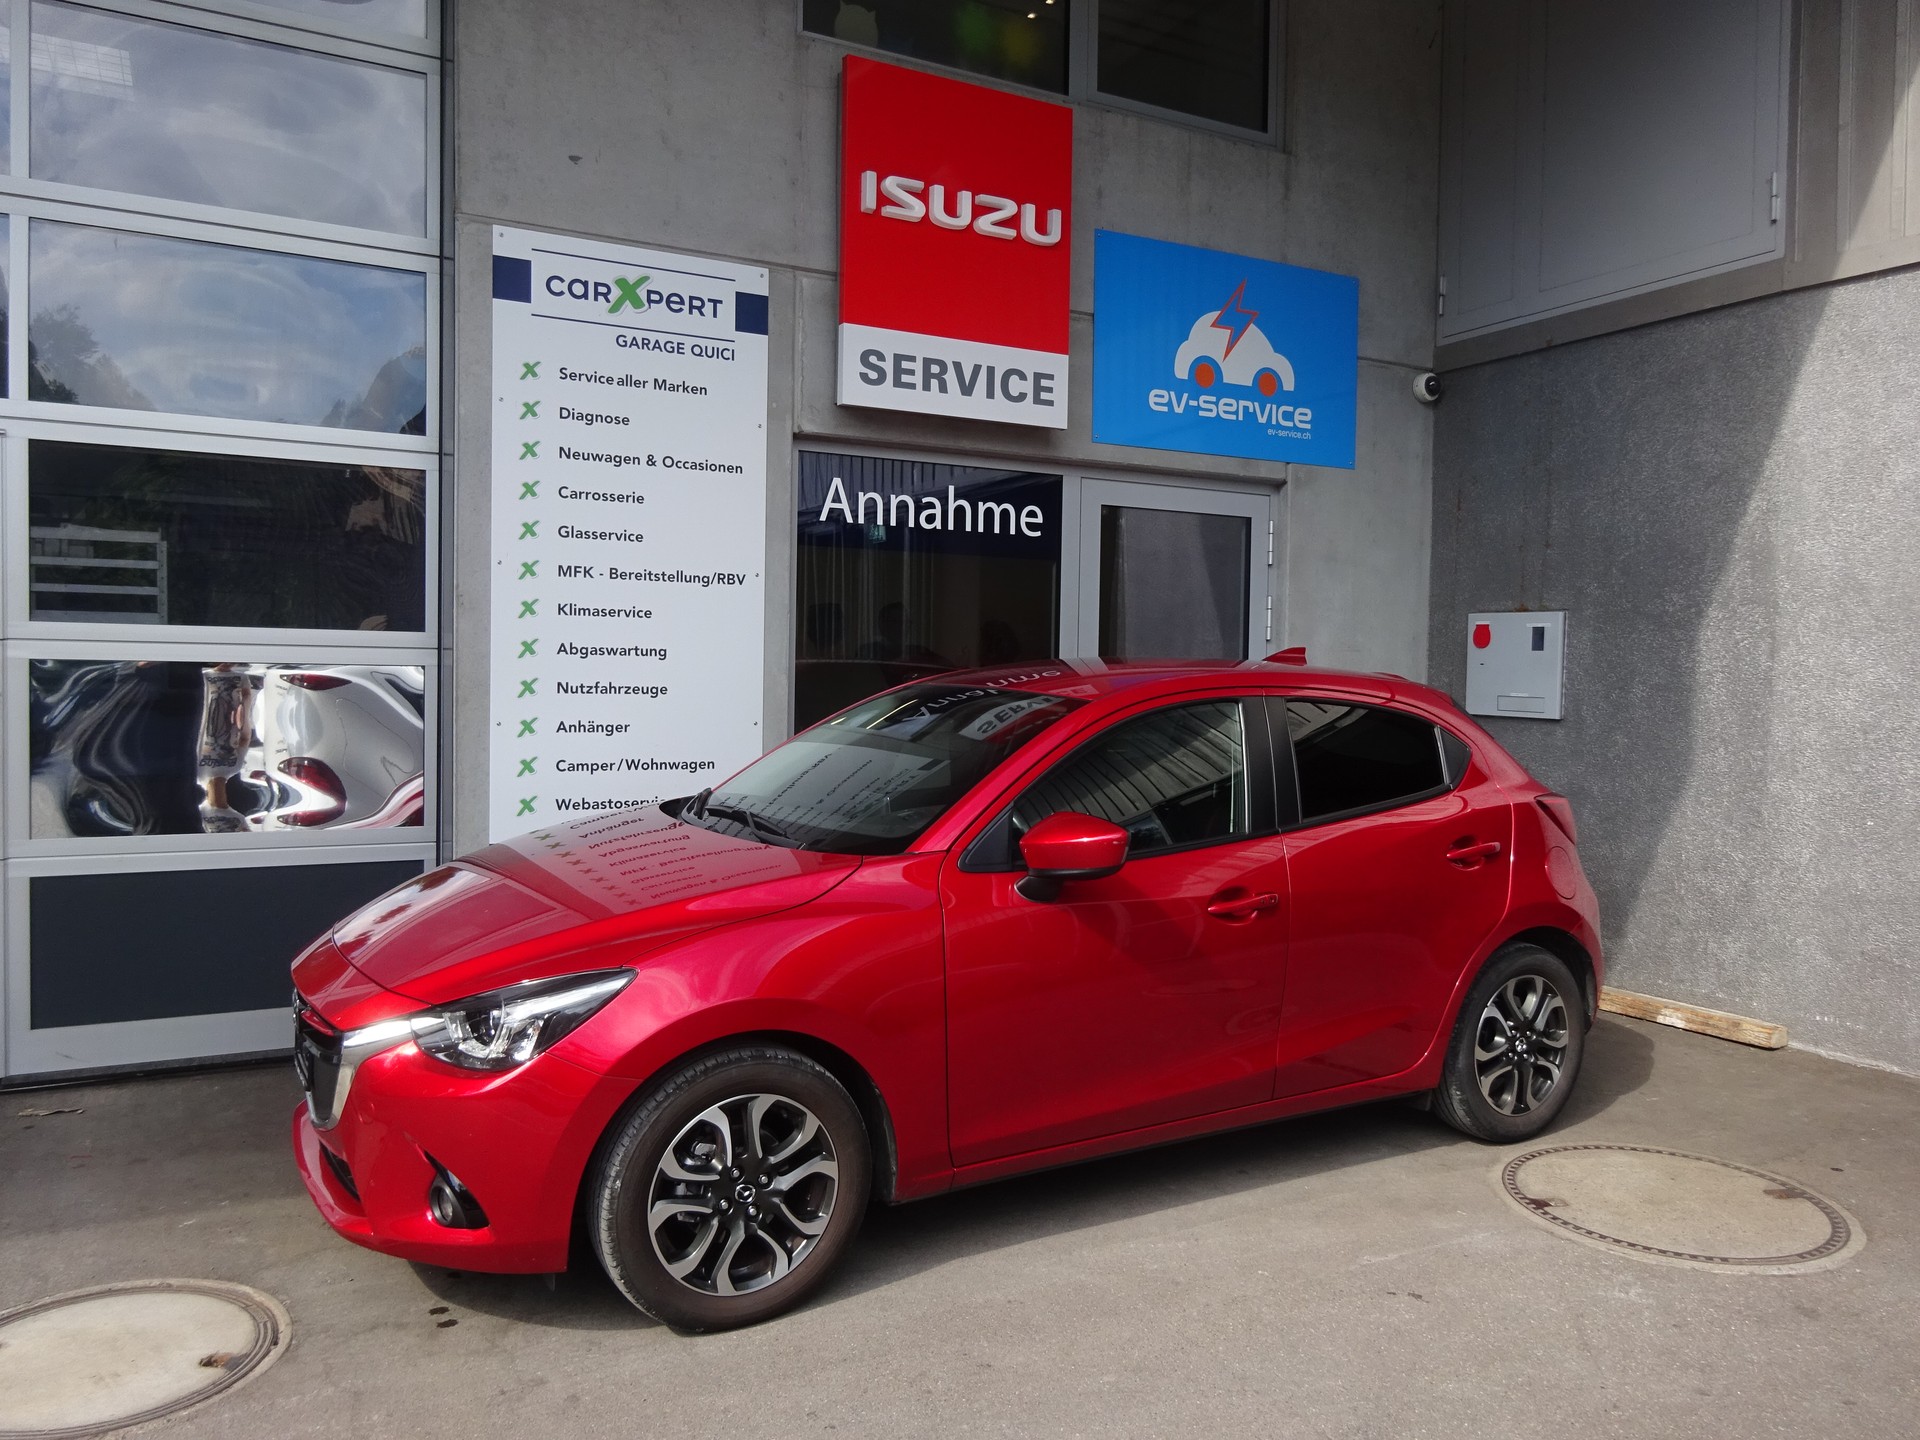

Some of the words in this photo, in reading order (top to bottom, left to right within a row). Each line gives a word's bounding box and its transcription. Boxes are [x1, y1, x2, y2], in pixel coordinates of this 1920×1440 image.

[861, 170, 1062, 247] ISUZU
[615, 334, 686, 355] GARAGE
[690, 343, 736, 362] QUICI
[559, 367, 615, 386] Service
[616, 373, 649, 390] aller
[653, 377, 708, 396] Marken
[858, 348, 1055, 407] SERVICE
[558, 406, 631, 426] Diagnose
[1148, 388, 1313, 429] ev-service
[1267, 428, 1312, 440] ev-service.ch
[558, 446, 641, 468] Neuwagen
[645, 454, 658, 467] &
[662, 455, 744, 475] Occasionen
[558, 485, 645, 505] Carrosserie
[819, 477, 1044, 537] Annahme
[557, 525, 644, 543] Glasservice
[557, 564, 595, 580] MFK
[609, 567, 747, 588] Bereitstellung/RBV
[557, 602, 653, 620] Klimaservice
[557, 642, 668, 661] Abgaswartung
[556, 681, 669, 699] Nutzfahrzeuge
[556, 719, 631, 737] Anhänger
[555, 796, 665, 810] Webastoser
